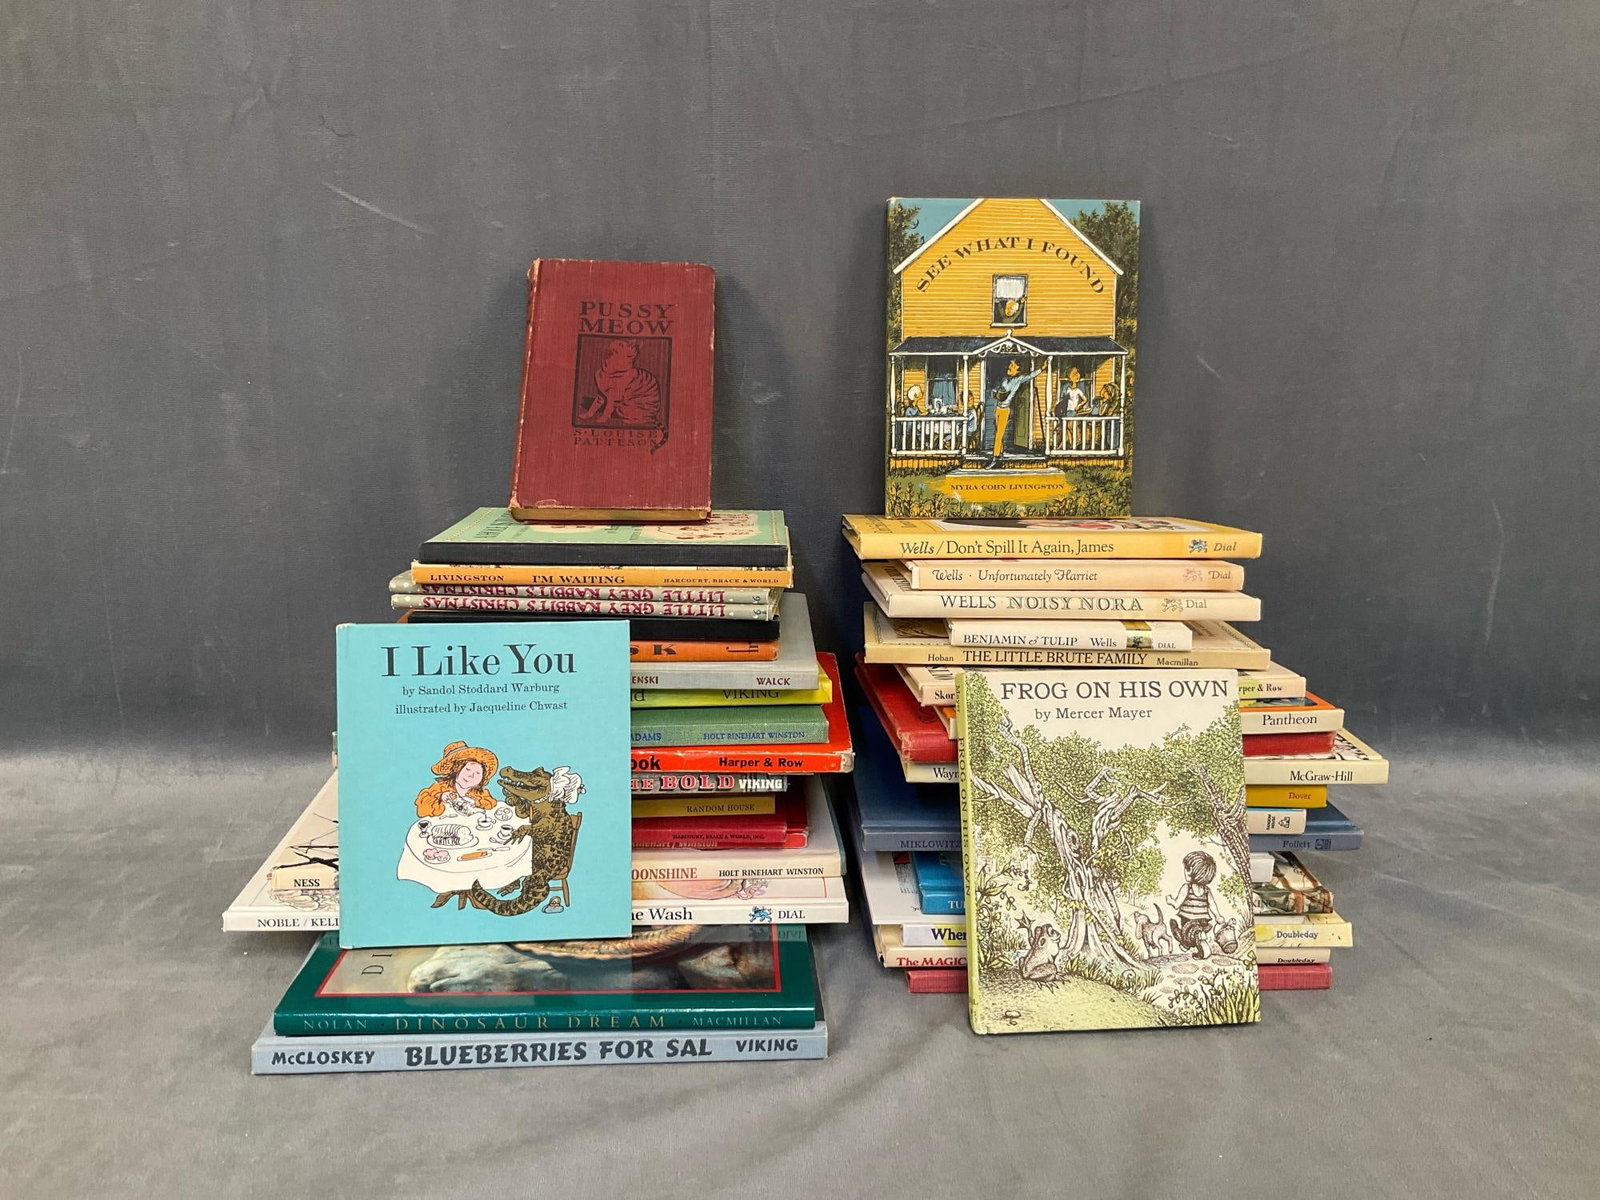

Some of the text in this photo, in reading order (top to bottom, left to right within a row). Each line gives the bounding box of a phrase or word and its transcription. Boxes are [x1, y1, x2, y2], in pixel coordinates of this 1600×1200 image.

[916, 236, 1105, 294] SEE WHAT I FOUND
[579, 301, 675, 318] PUSSY
[578, 318, 674, 335] MEOW
[1008, 483, 1065, 491] LIVINGSTON
[900, 541, 935, 554] Wells
[946, 540, 983, 554] Don't
[985, 540, 1015, 556] Spill
[1018, 540, 1029, 553] It
[1031, 540, 1074, 556] Again,
[1075, 539, 1114, 556] James
[1213, 542, 1236, 552] Dial
[429, 574, 505, 583] LIVINGSTON
[532, 574, 556, 584] I'M
[559, 574, 626, 585] WAITING
[932, 569, 1098, 583] Wells Unfortunately Harriet
[1208, 571, 1231, 580] Dial
[420, 584, 726, 604] LITTLE GREY RABBIT'S CHRISTMAS
[422, 596, 520, 612] CHRISTMAS
[526, 599, 600, 614] RABBIT'S
[607, 601, 655, 615] GREY
[662, 603, 726, 617] LITTLE
[940, 595, 1144, 611] WELLS NOISY NORA
[1185, 599, 1207, 609] Dial
[963, 634, 1026, 645] BENJAMIN
[1043, 636, 1078, 647] TULIP
[1090, 637, 1117, 648] Wells
[380, 643, 578, 677] I Like You
[927, 650, 1199, 667] Hoban THE LITTLE BRUTE FAMILY Macmillan
[756, 677, 791, 686] WALCK
[1257, 684, 1263, 692] &
[1266, 683, 1282, 692] Row
[402, 682, 560, 697] by Sandol Stoddard Warburg
[722, 689, 779, 700] VIKING
[1000, 680, 1228, 700] FROG ON HIS OWN
[395, 700, 569, 715] illustrated by Jacqueline Chwast
[1035, 707, 1153, 722] by Mercer Mayer
[1262, 713, 1317, 726] Pantheon
[703, 732, 726, 740] HOLT
[727, 731, 765, 740] RINEHART
[767, 731, 805, 739] WINSTON
[719, 757, 761, 769] Harper
[763, 757, 774, 767] &
[778, 757, 803, 768] Row
[959, 737, 967, 782] FROG
[660, 775, 735, 791] BOLD
[739, 778, 783, 790] VIKING
[1290, 771, 1353, 782] McGraw-Hill
[961, 793, 968, 812] ON
[1288, 792, 1312, 800] Dover
[686, 805, 725, 813] RANDOM
[1282, 840, 1311, 848] Follett
[719, 869, 740, 878] HOLT
[742, 868, 782, 877] RINEHART
[786, 867, 824, 876] WINSTON
[963, 853, 971, 896] OWN
[293, 878, 320, 888] NESS
[649, 907, 693, 920] Wash
[778, 910, 806, 920] DIAL
[257, 918, 300, 928] NOBLE
[1276, 930, 1319, 940] Doubleday
[896, 957, 919, 966] The
[303, 1014, 783, 1031] NOLAN DINOSAUR DREAM MACMILLAN
[271, 1038, 799, 1067] McCLOSKEY BLUEBERRIES FOR SAL VIKING
